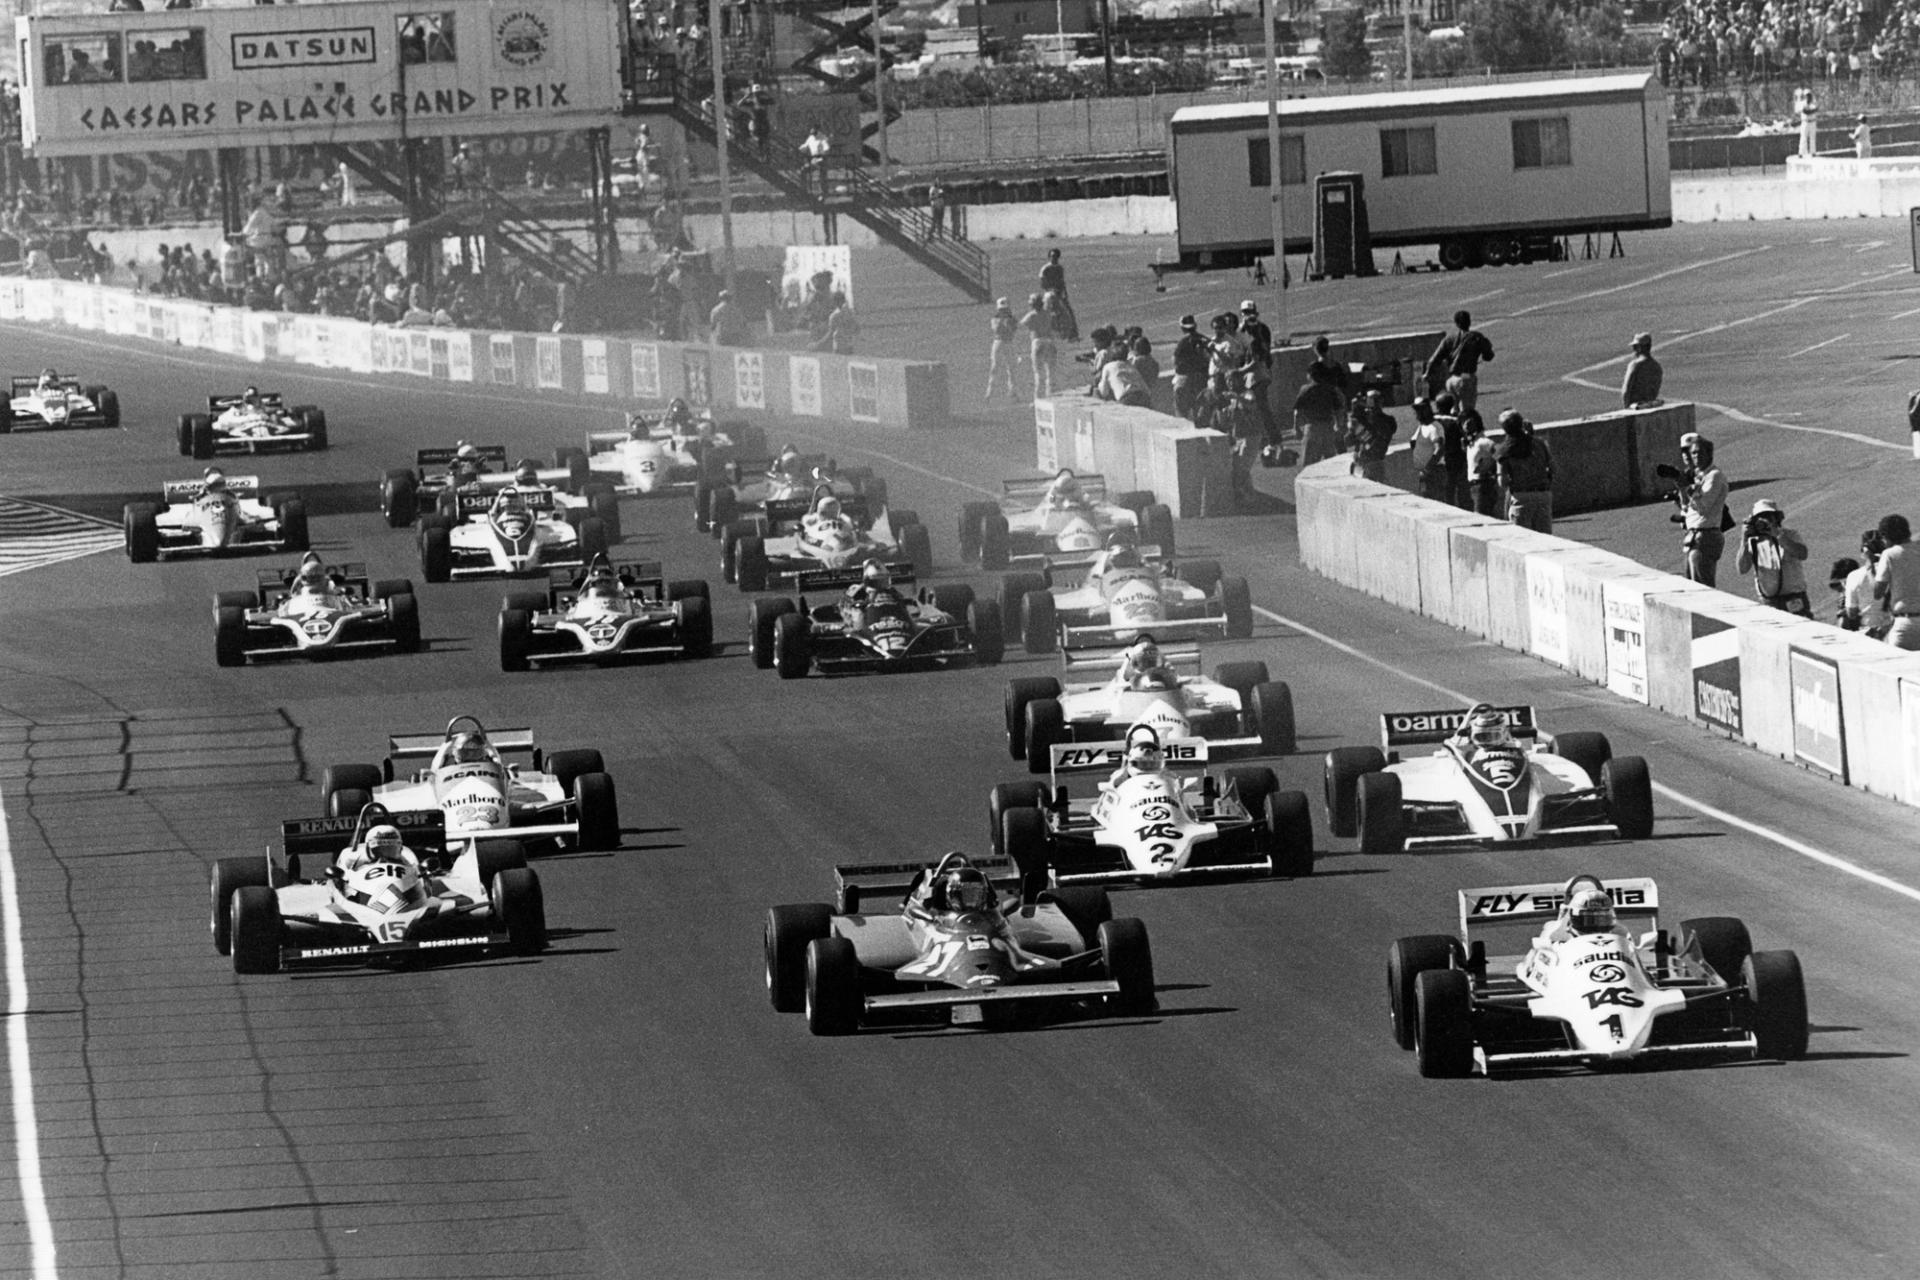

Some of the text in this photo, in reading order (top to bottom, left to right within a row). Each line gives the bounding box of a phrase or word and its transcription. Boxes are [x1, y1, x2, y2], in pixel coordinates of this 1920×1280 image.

[241, 37, 367, 59] DATSUN
[81, 82, 569, 130] CAESARS PALACE GRAND PRIX
[640, 461, 656, 473] 3
[463, 493, 546, 507] parlat
[1058, 744, 1196, 766] FLY sdia
[1490, 764, 1515, 784] 5
[442, 793, 506, 808] Marlboro
[397, 814, 428, 826] elf
[456, 806, 500, 827] 23
[1149, 843, 1178, 864] 2
[364, 864, 406, 881] elf
[1472, 893, 1530, 915] FLY
[379, 921, 407, 942] 15
[301, 945, 370, 958] RENAULT
[418, 936, 489, 949] MICHELIN
[1573, 951, 1636, 968] saudia
[1598, 1013, 1624, 1039] 1
